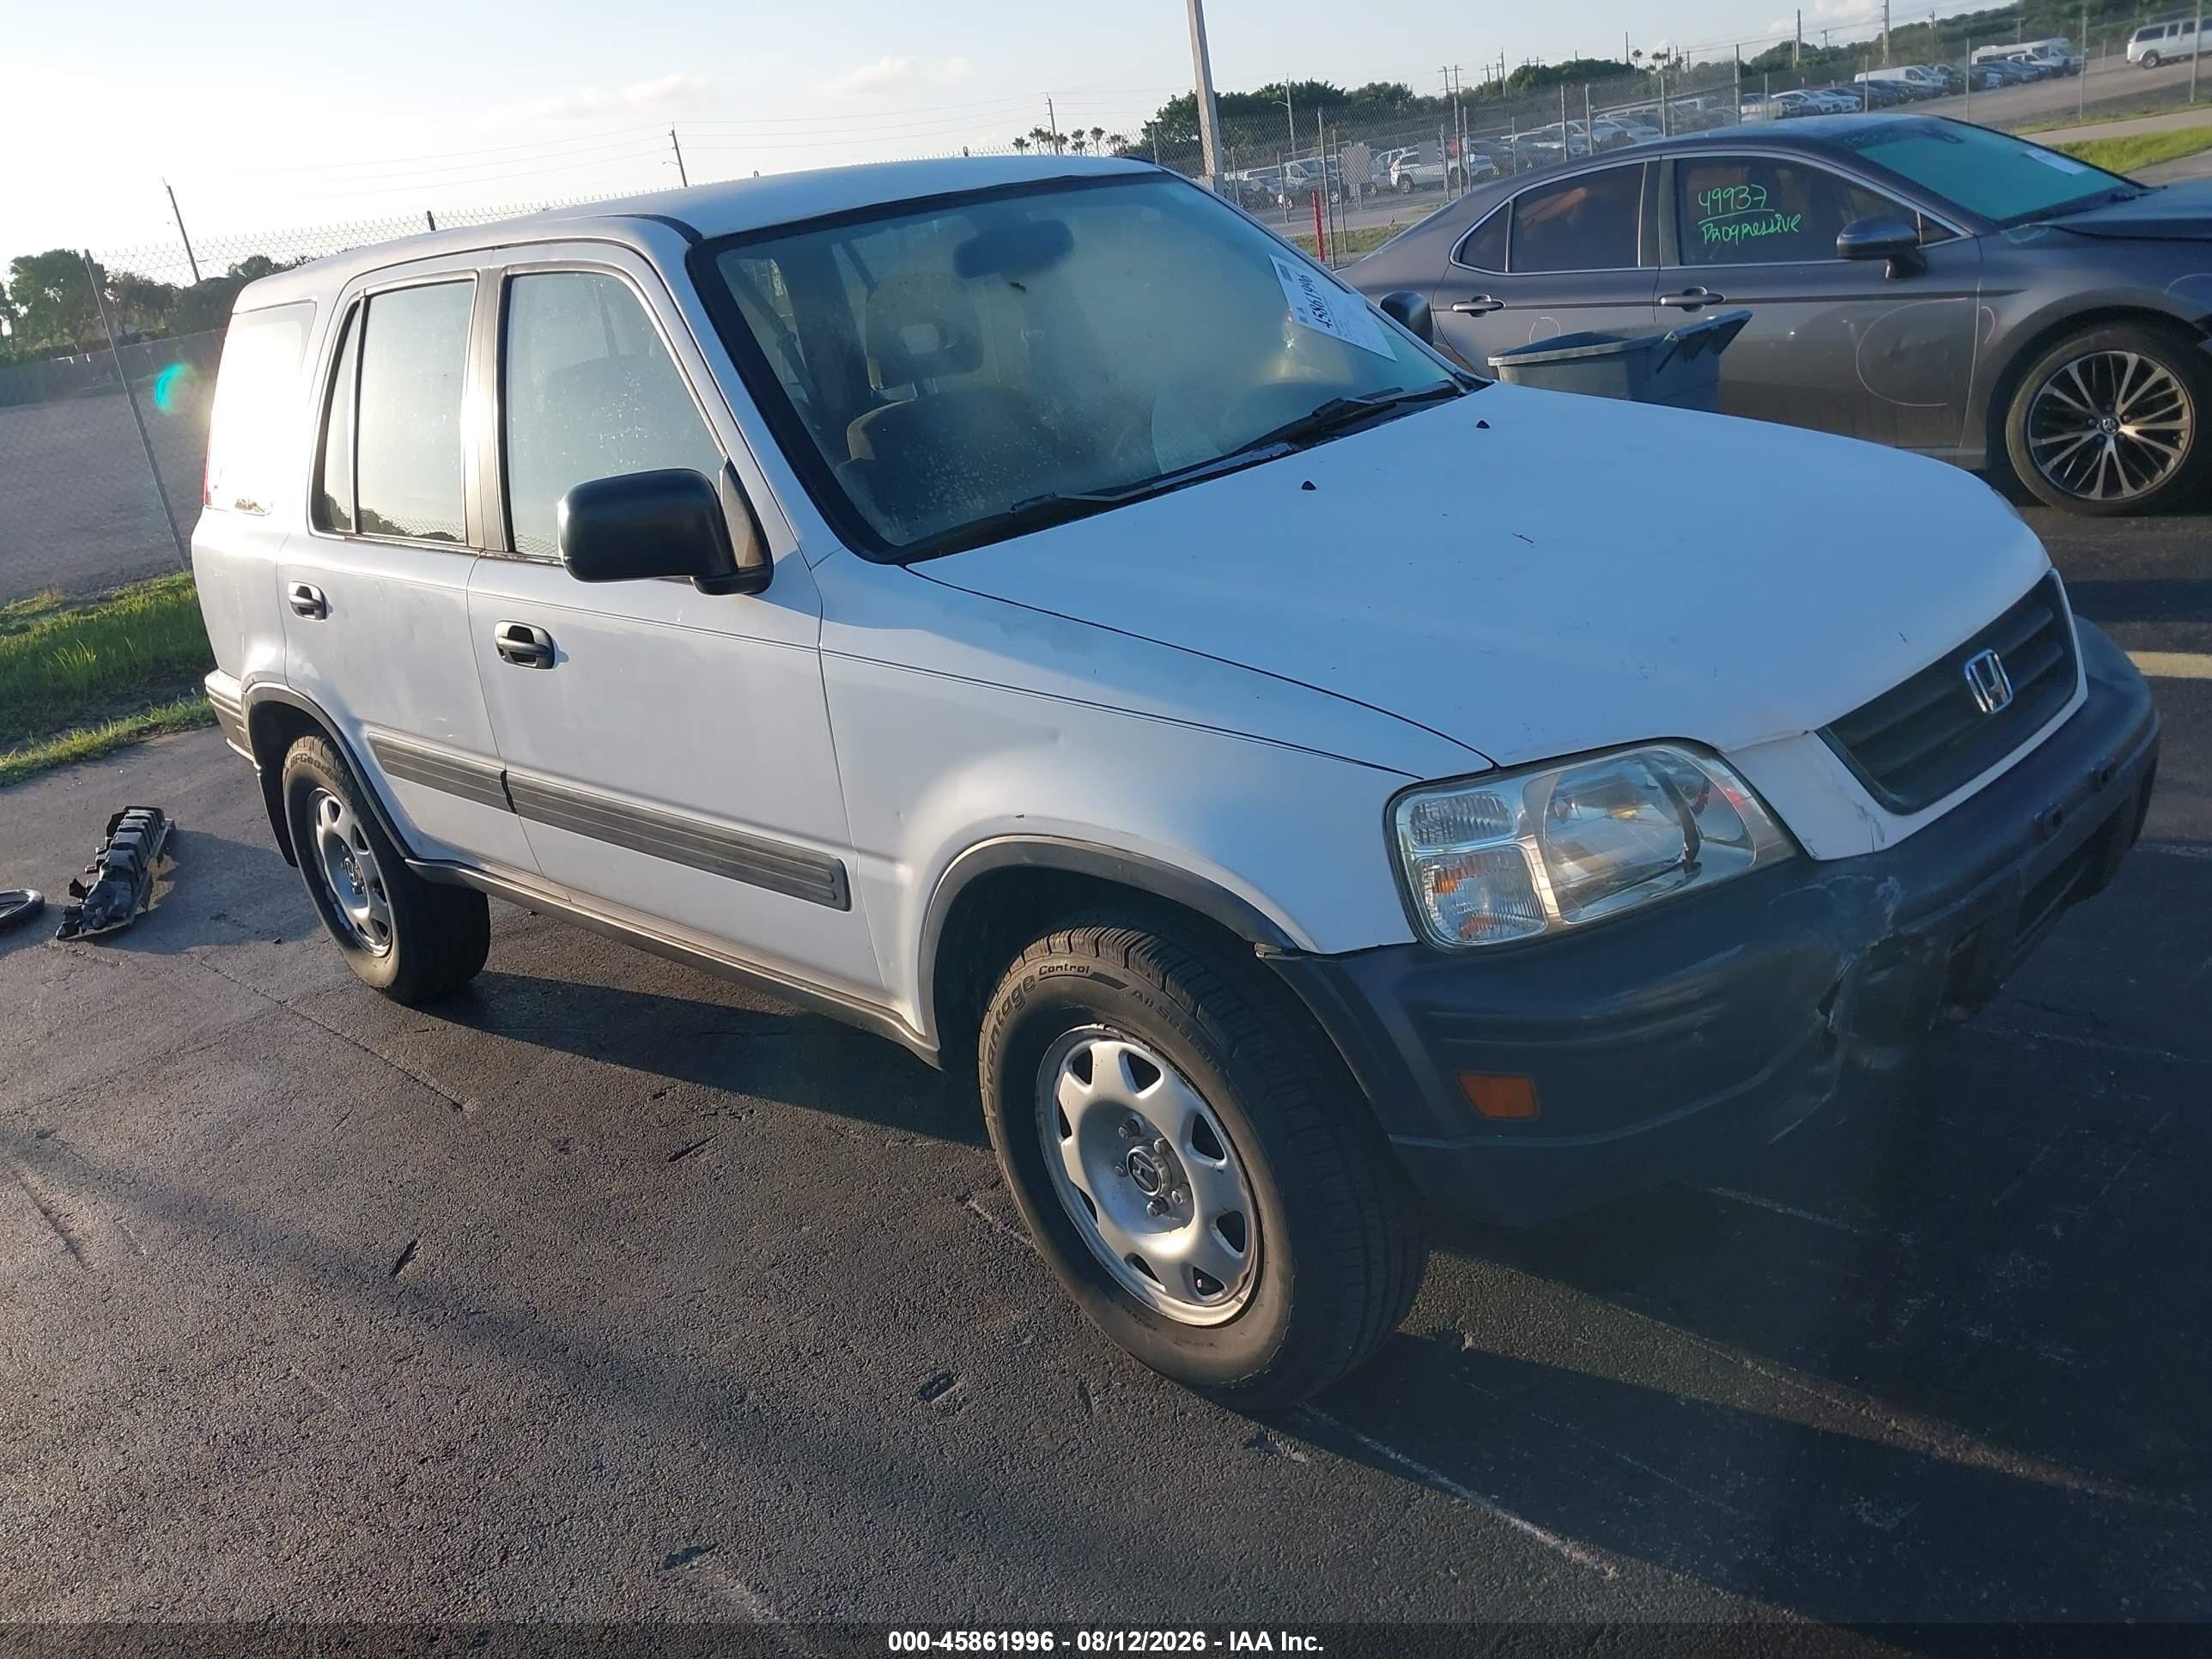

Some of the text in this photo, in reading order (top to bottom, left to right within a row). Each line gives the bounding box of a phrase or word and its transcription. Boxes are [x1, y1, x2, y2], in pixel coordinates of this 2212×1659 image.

[1698, 183, 1768, 216] 49937
[1297, 272, 1334, 329] 45861996
[1038, 963, 1091, 976] Control
